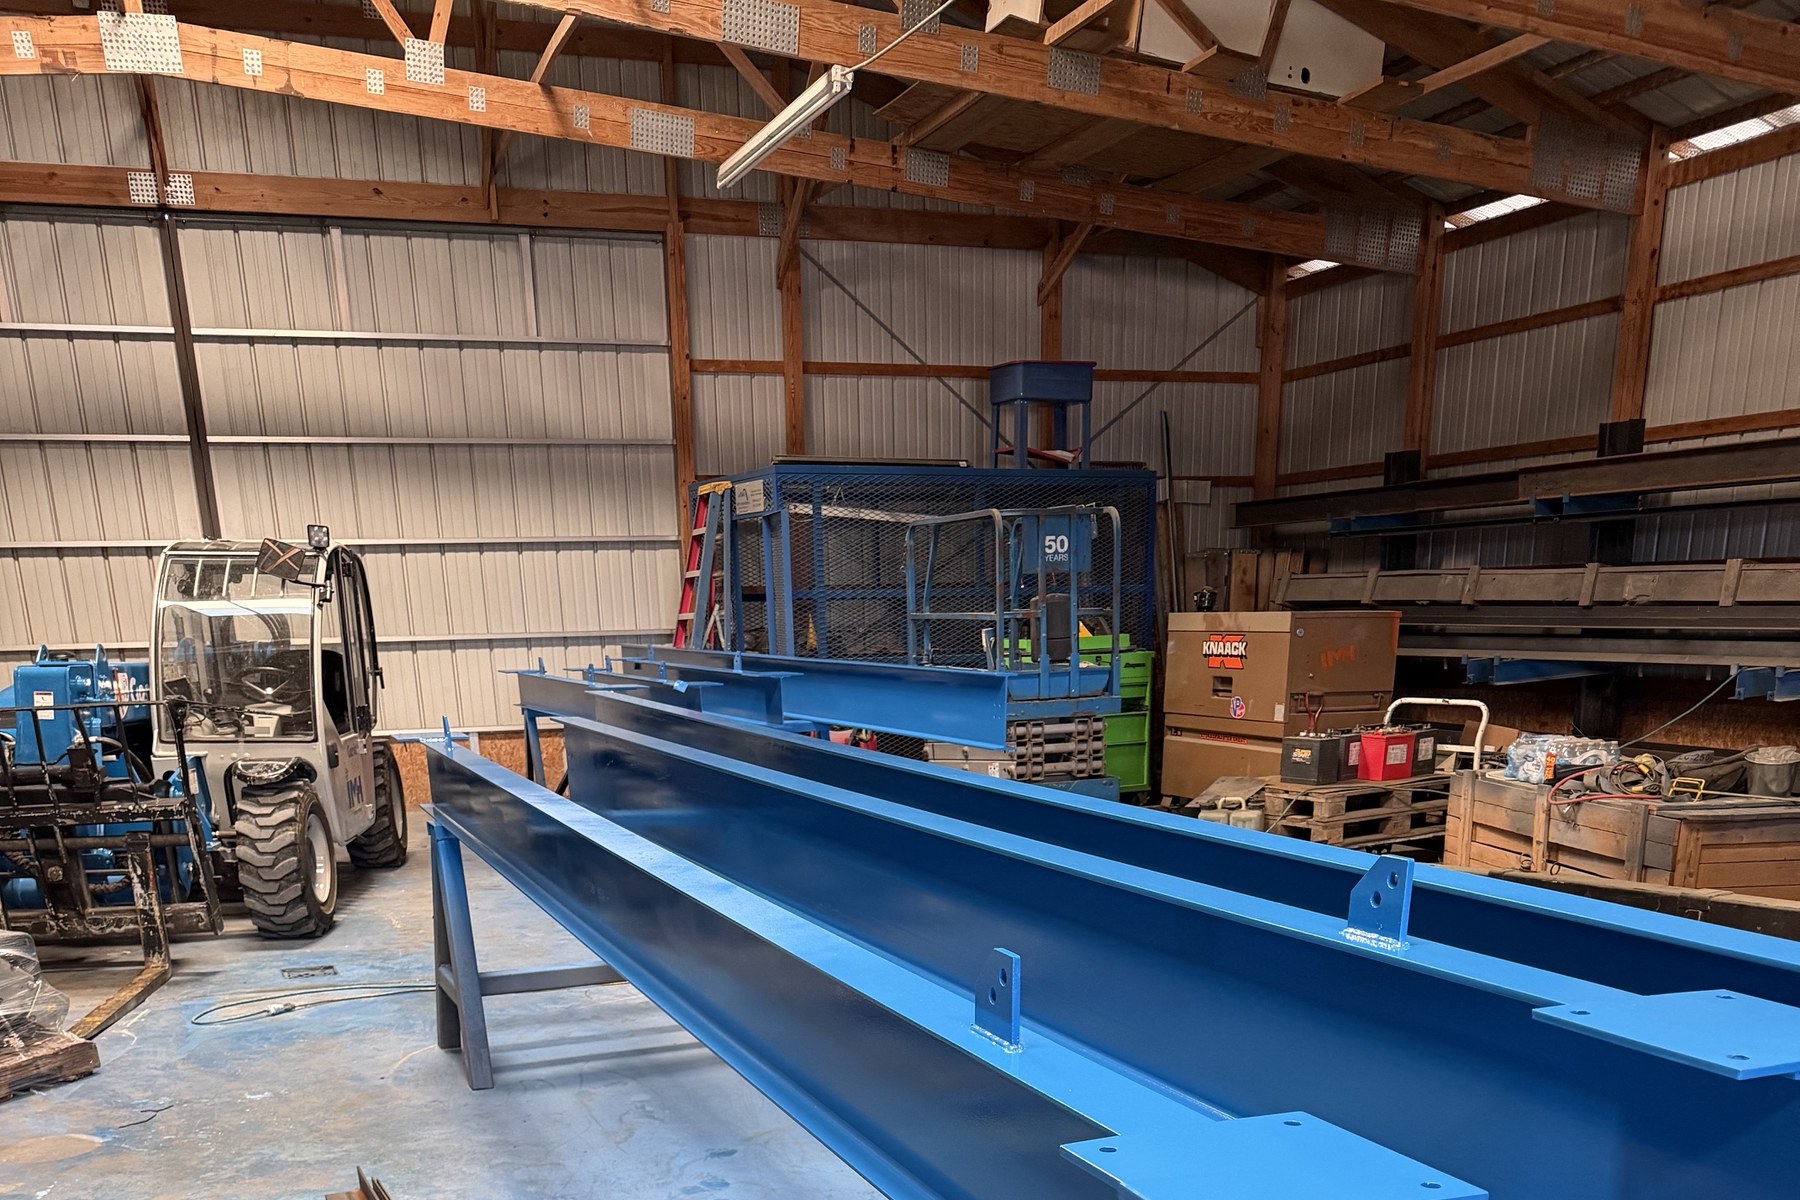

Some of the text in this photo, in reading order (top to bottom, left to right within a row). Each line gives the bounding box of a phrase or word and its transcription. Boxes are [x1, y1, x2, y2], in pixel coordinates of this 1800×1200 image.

[1045, 535, 1069, 554] 50
[1045, 554, 1069, 562] YEARS
[1202, 641, 1247, 658] KNAACK
